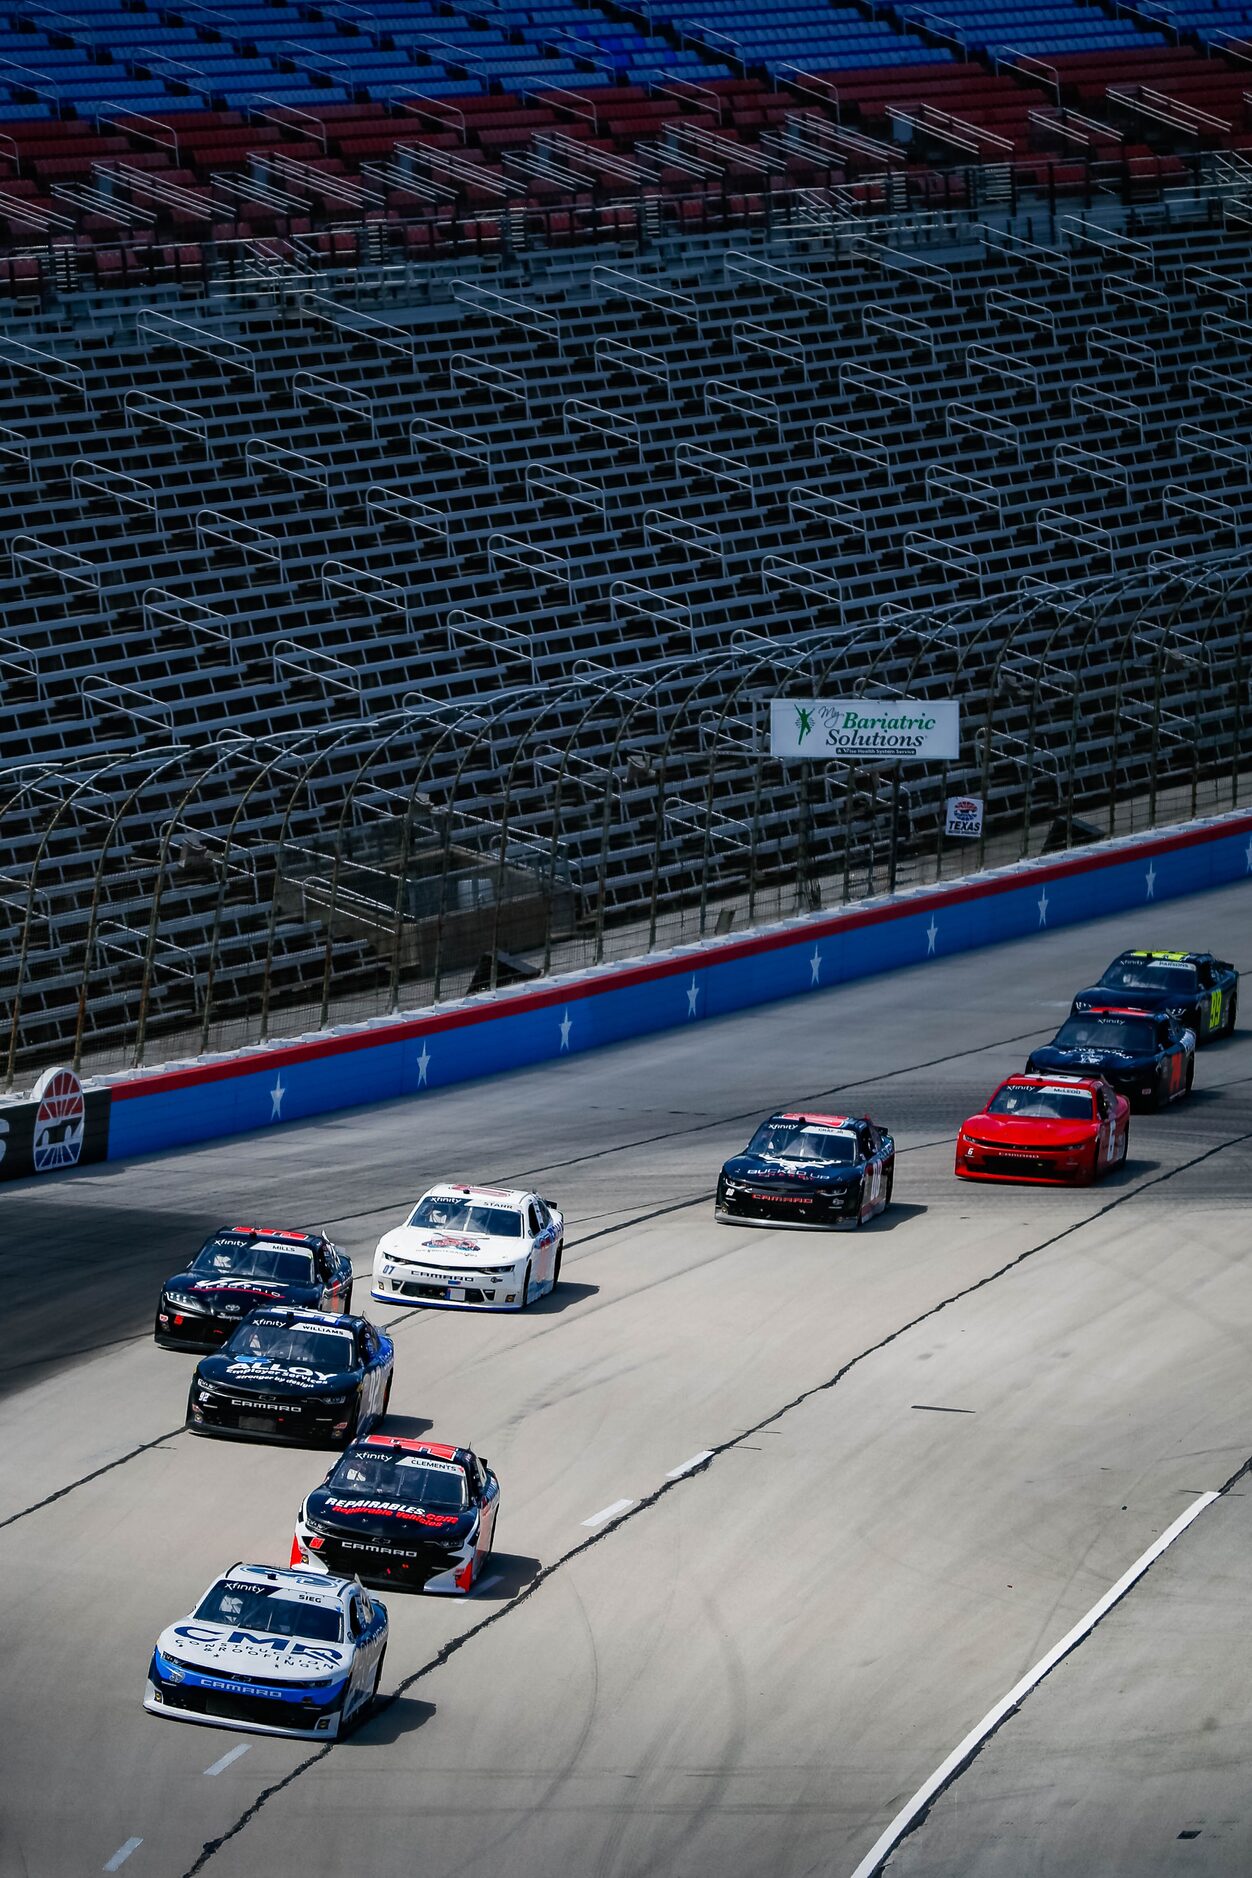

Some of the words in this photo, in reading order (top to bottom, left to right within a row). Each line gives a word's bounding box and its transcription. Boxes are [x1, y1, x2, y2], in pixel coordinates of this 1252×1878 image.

[818, 706, 845, 728] My
[842, 711, 936, 730] Bariatric
[826, 729, 925, 746] Solutions
[949, 820, 981, 832] TEXAS
[430, 1196, 462, 1204] xfinity
[751, 1193, 814, 1204] CAMARO
[484, 1201, 513, 1209] STARR
[214, 1238, 248, 1248] xfinity
[272, 1244, 296, 1252] MILLS
[382, 1264, 396, 1275] 07
[410, 1270, 474, 1282] CAMARO
[252, 1318, 287, 1328] xfinity
[302, 1324, 345, 1335] WILLIAMS
[226, 1362, 338, 1381] ALLOY
[226, 1368, 281, 1376] Employer
[281, 1371, 328, 1385] Services
[286, 1378, 315, 1389] design
[198, 1391, 211, 1402] 92
[231, 1399, 302, 1413] CAMARO
[355, 1452, 393, 1462] xfinity
[411, 1459, 457, 1471] CLEMENTS
[341, 1541, 418, 1558] CAMARO
[224, 1582, 265, 1594] xfinity
[298, 1594, 322, 1603] SIEG
[174, 1626, 343, 1667] CMR
[175, 1639, 334, 1669] CONSTRUCTION
[218, 1646, 310, 1668] ROOFING
[200, 1679, 282, 1698] CAMARO
